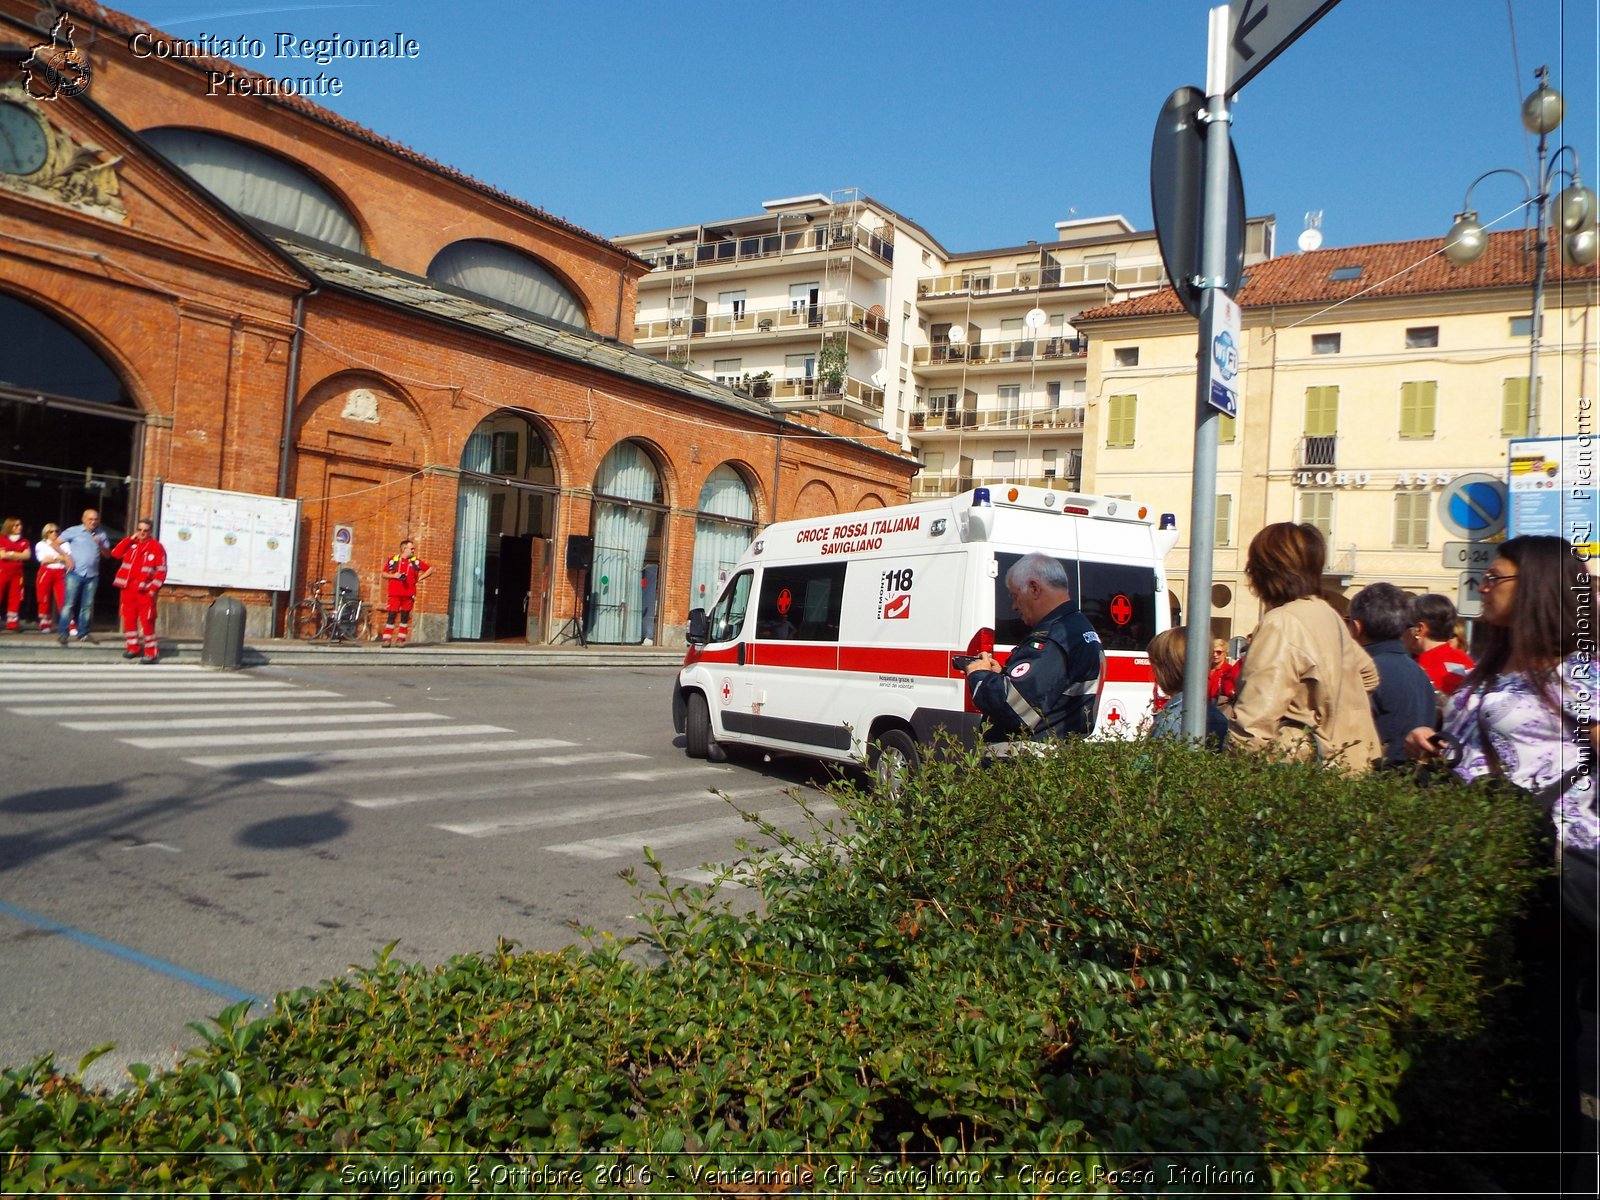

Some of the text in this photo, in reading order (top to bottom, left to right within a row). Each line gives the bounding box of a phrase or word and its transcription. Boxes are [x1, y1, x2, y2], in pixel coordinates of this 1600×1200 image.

[1297, 471, 1450, 486] TORO ASS
[796, 516, 920, 544] CROCE ROSSA ITALIANA
[820, 537, 883, 555] SAVIGLIANO
[885, 568, 914, 592] 118
[877, 570, 887, 620] PIEMONTE
